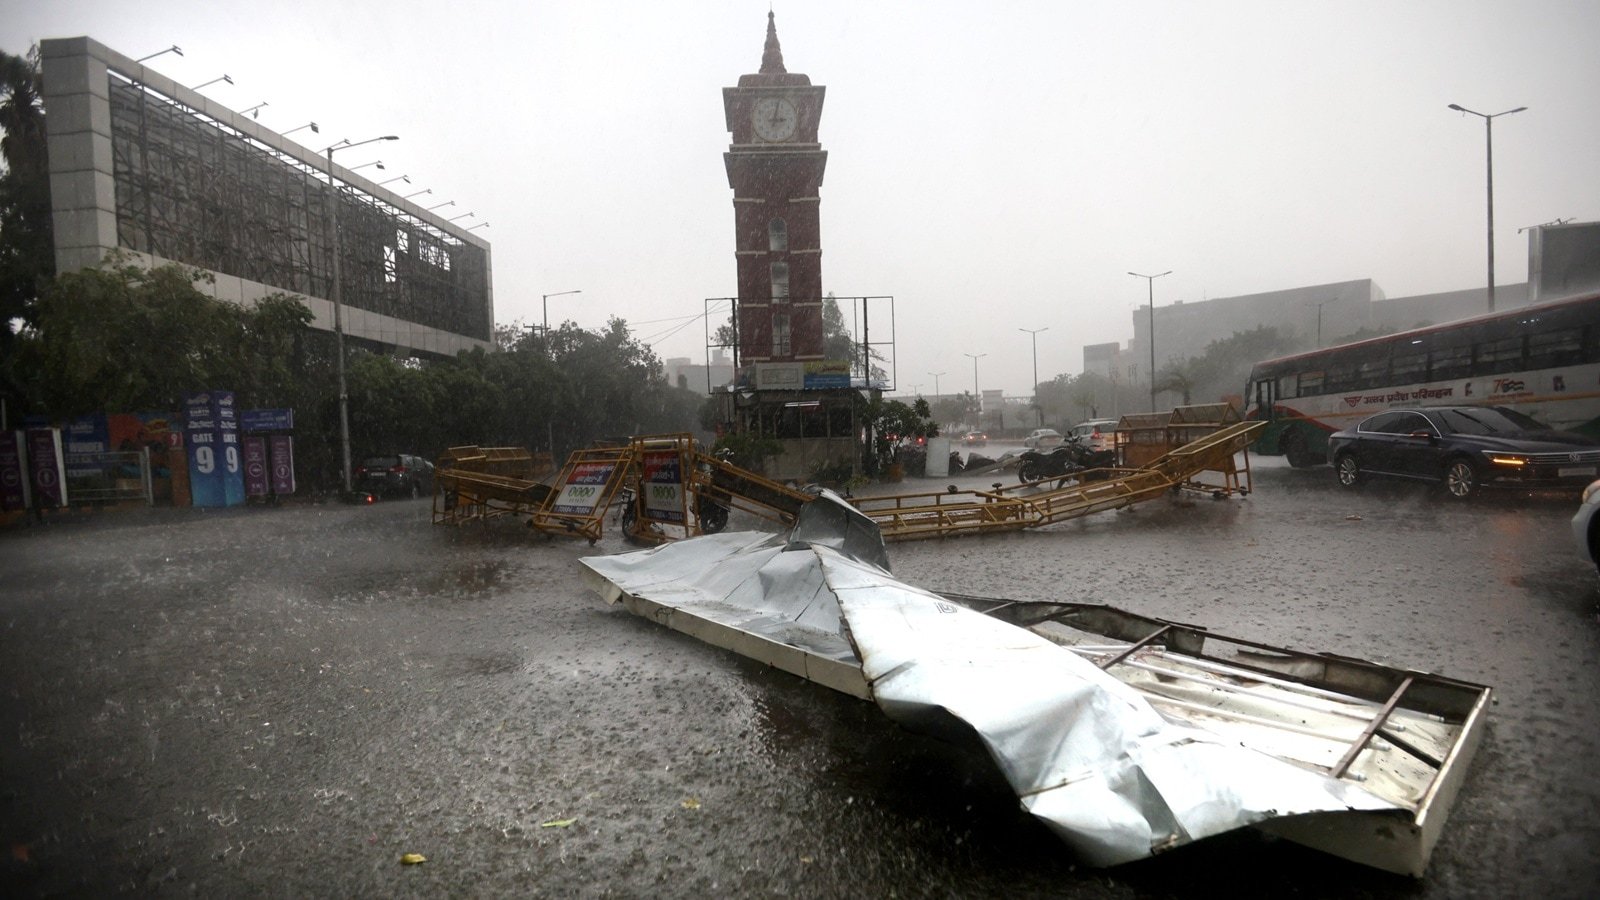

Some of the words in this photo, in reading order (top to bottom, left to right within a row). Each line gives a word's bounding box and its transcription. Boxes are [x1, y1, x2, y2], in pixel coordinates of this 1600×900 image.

[192, 433, 213, 443] GATE
[196, 446, 215, 474] 9
[226, 446, 238, 473] 9
